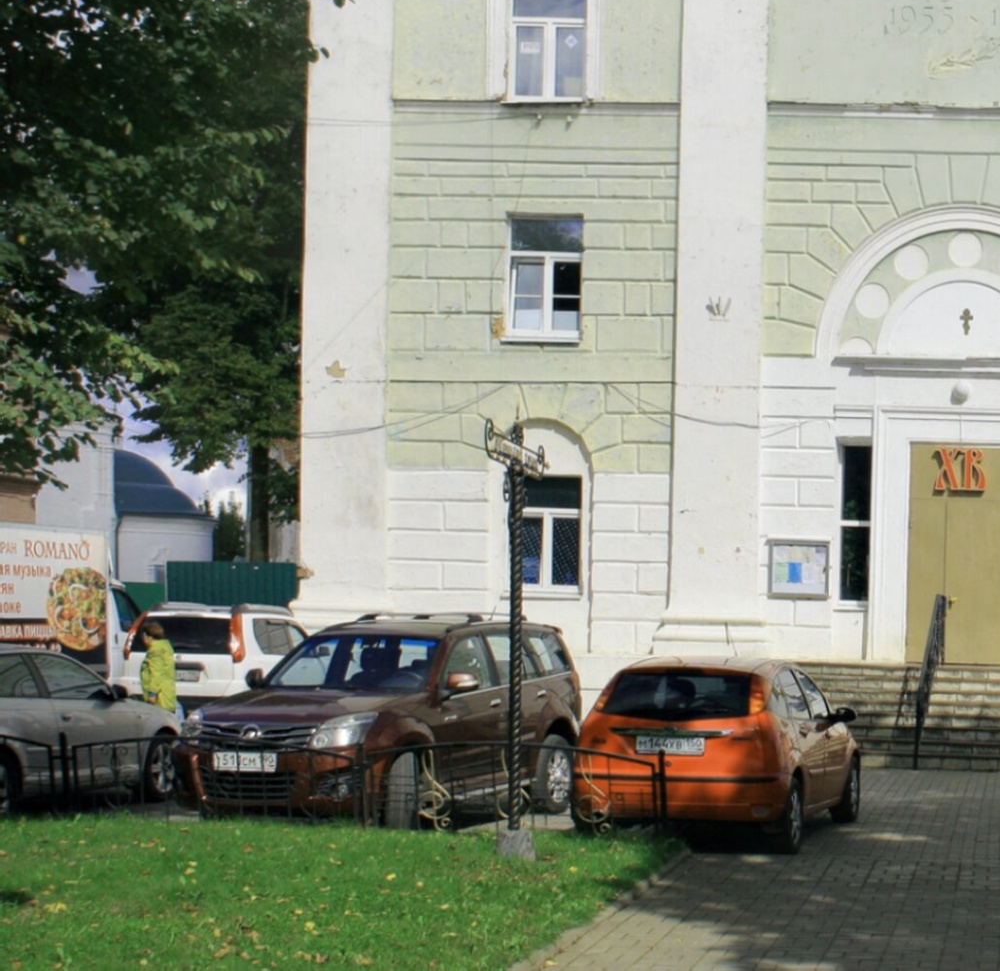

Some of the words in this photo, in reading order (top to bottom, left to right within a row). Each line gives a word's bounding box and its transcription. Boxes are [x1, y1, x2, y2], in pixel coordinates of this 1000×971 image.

[890, 4, 954, 35] 1955
[23, 539, 91, 561] ROMANO
[13, 565, 52, 580] музыка
